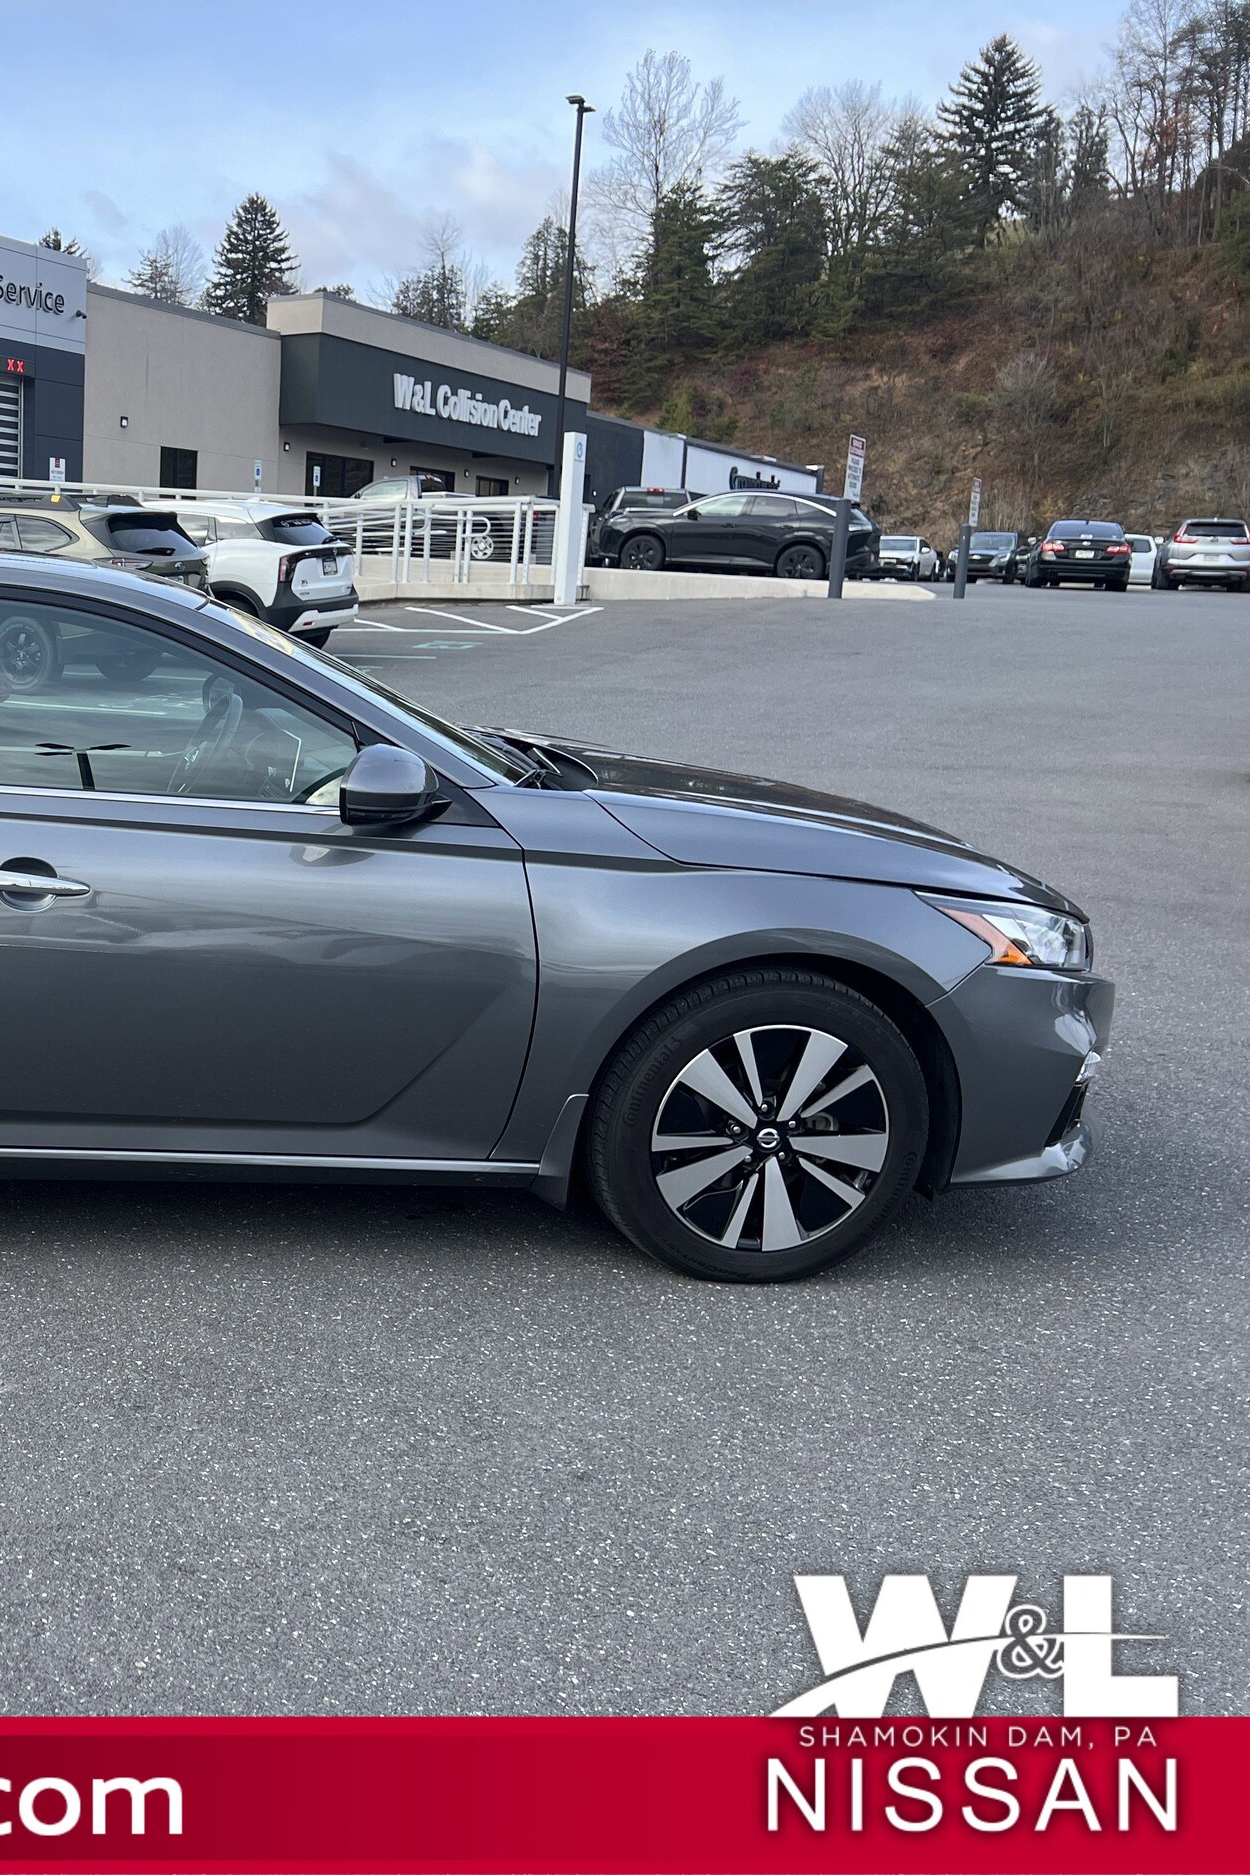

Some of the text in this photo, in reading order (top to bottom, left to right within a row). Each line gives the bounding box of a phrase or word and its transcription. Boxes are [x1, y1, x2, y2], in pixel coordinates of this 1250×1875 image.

[393, 372, 543, 437] W&L Collision Center
[623, 1044, 675, 1126] Continental
